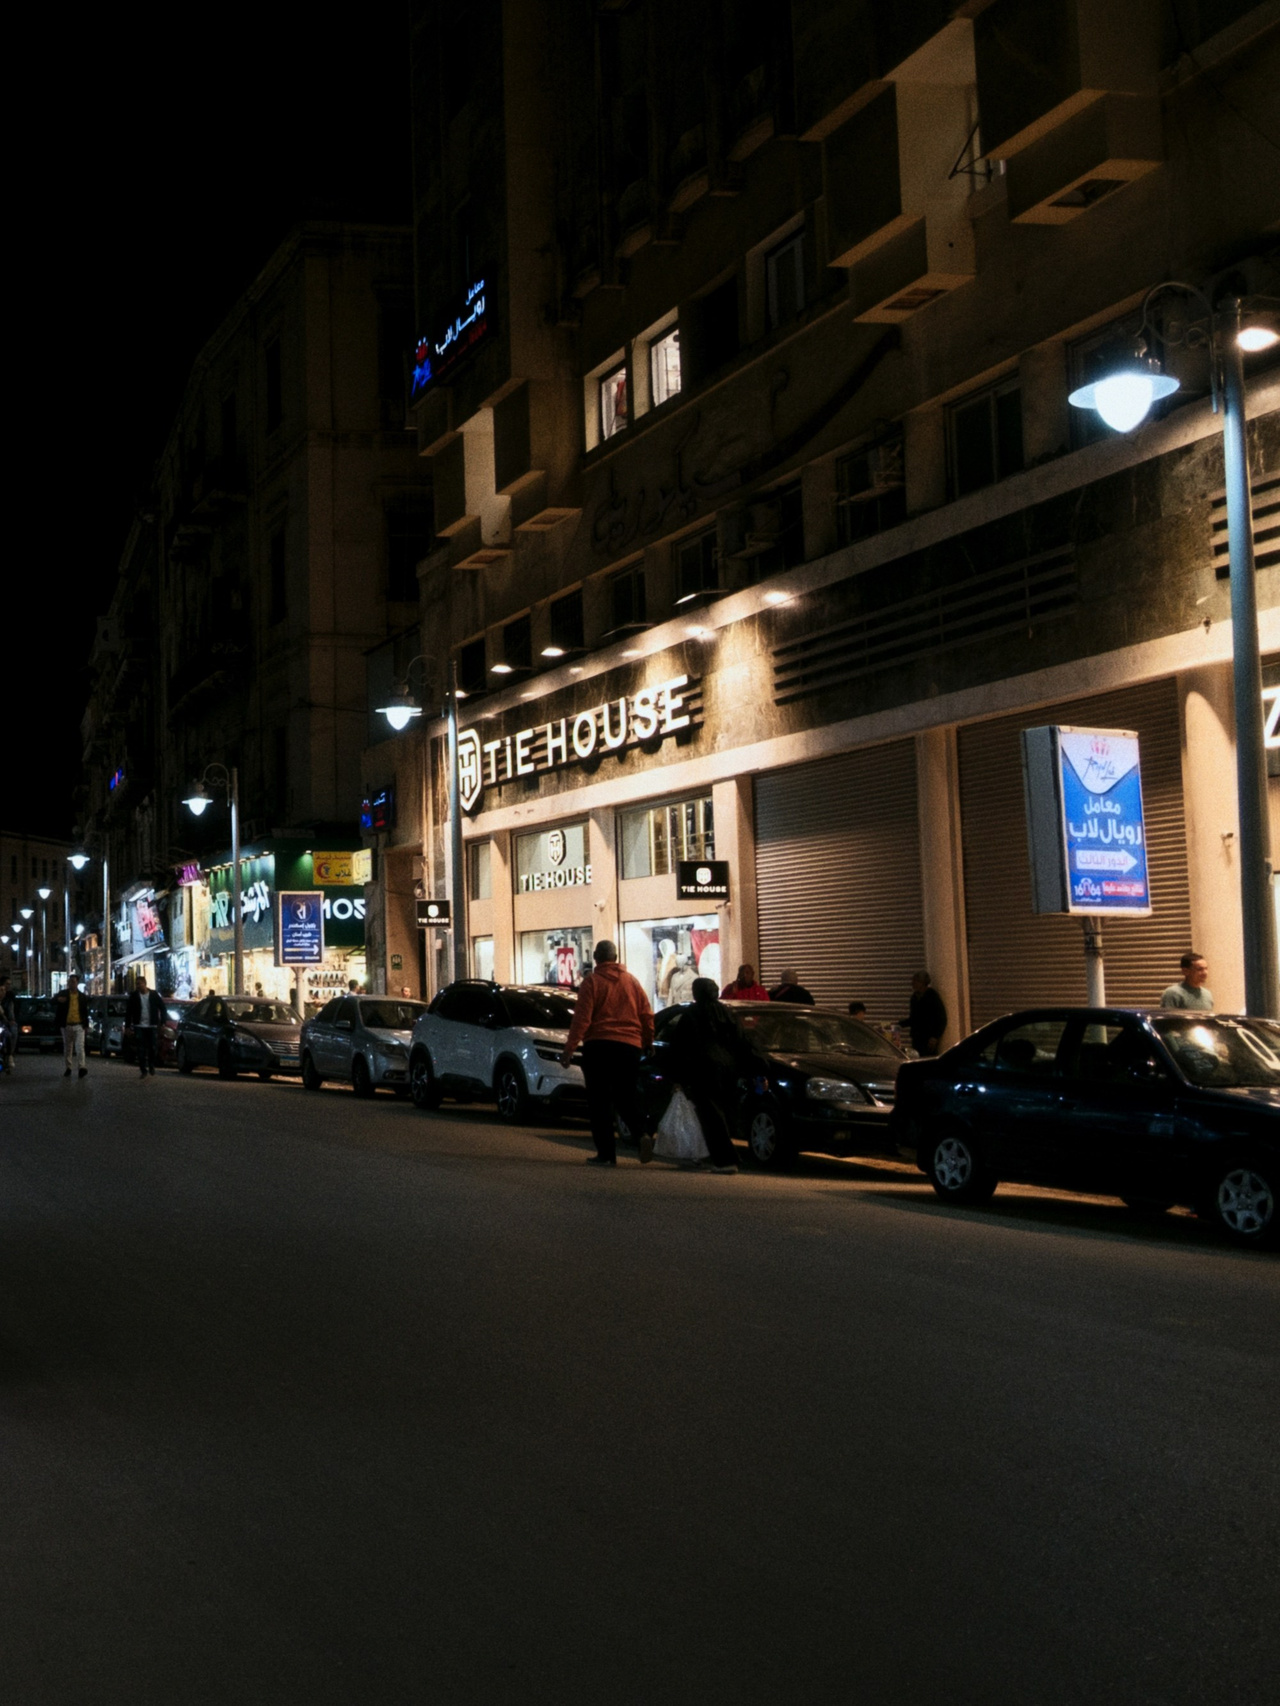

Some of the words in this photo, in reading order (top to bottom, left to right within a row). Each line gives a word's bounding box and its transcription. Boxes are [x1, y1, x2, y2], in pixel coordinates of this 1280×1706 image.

[546, 674, 690, 767] HOUSE
[1083, 796, 1121, 815] معامل
[1069, 817, 1099, 842] لاب
[1100, 818, 1142, 845] رويال
[520, 872, 542, 892] TIE
[545, 864, 592, 889] HOUSE
